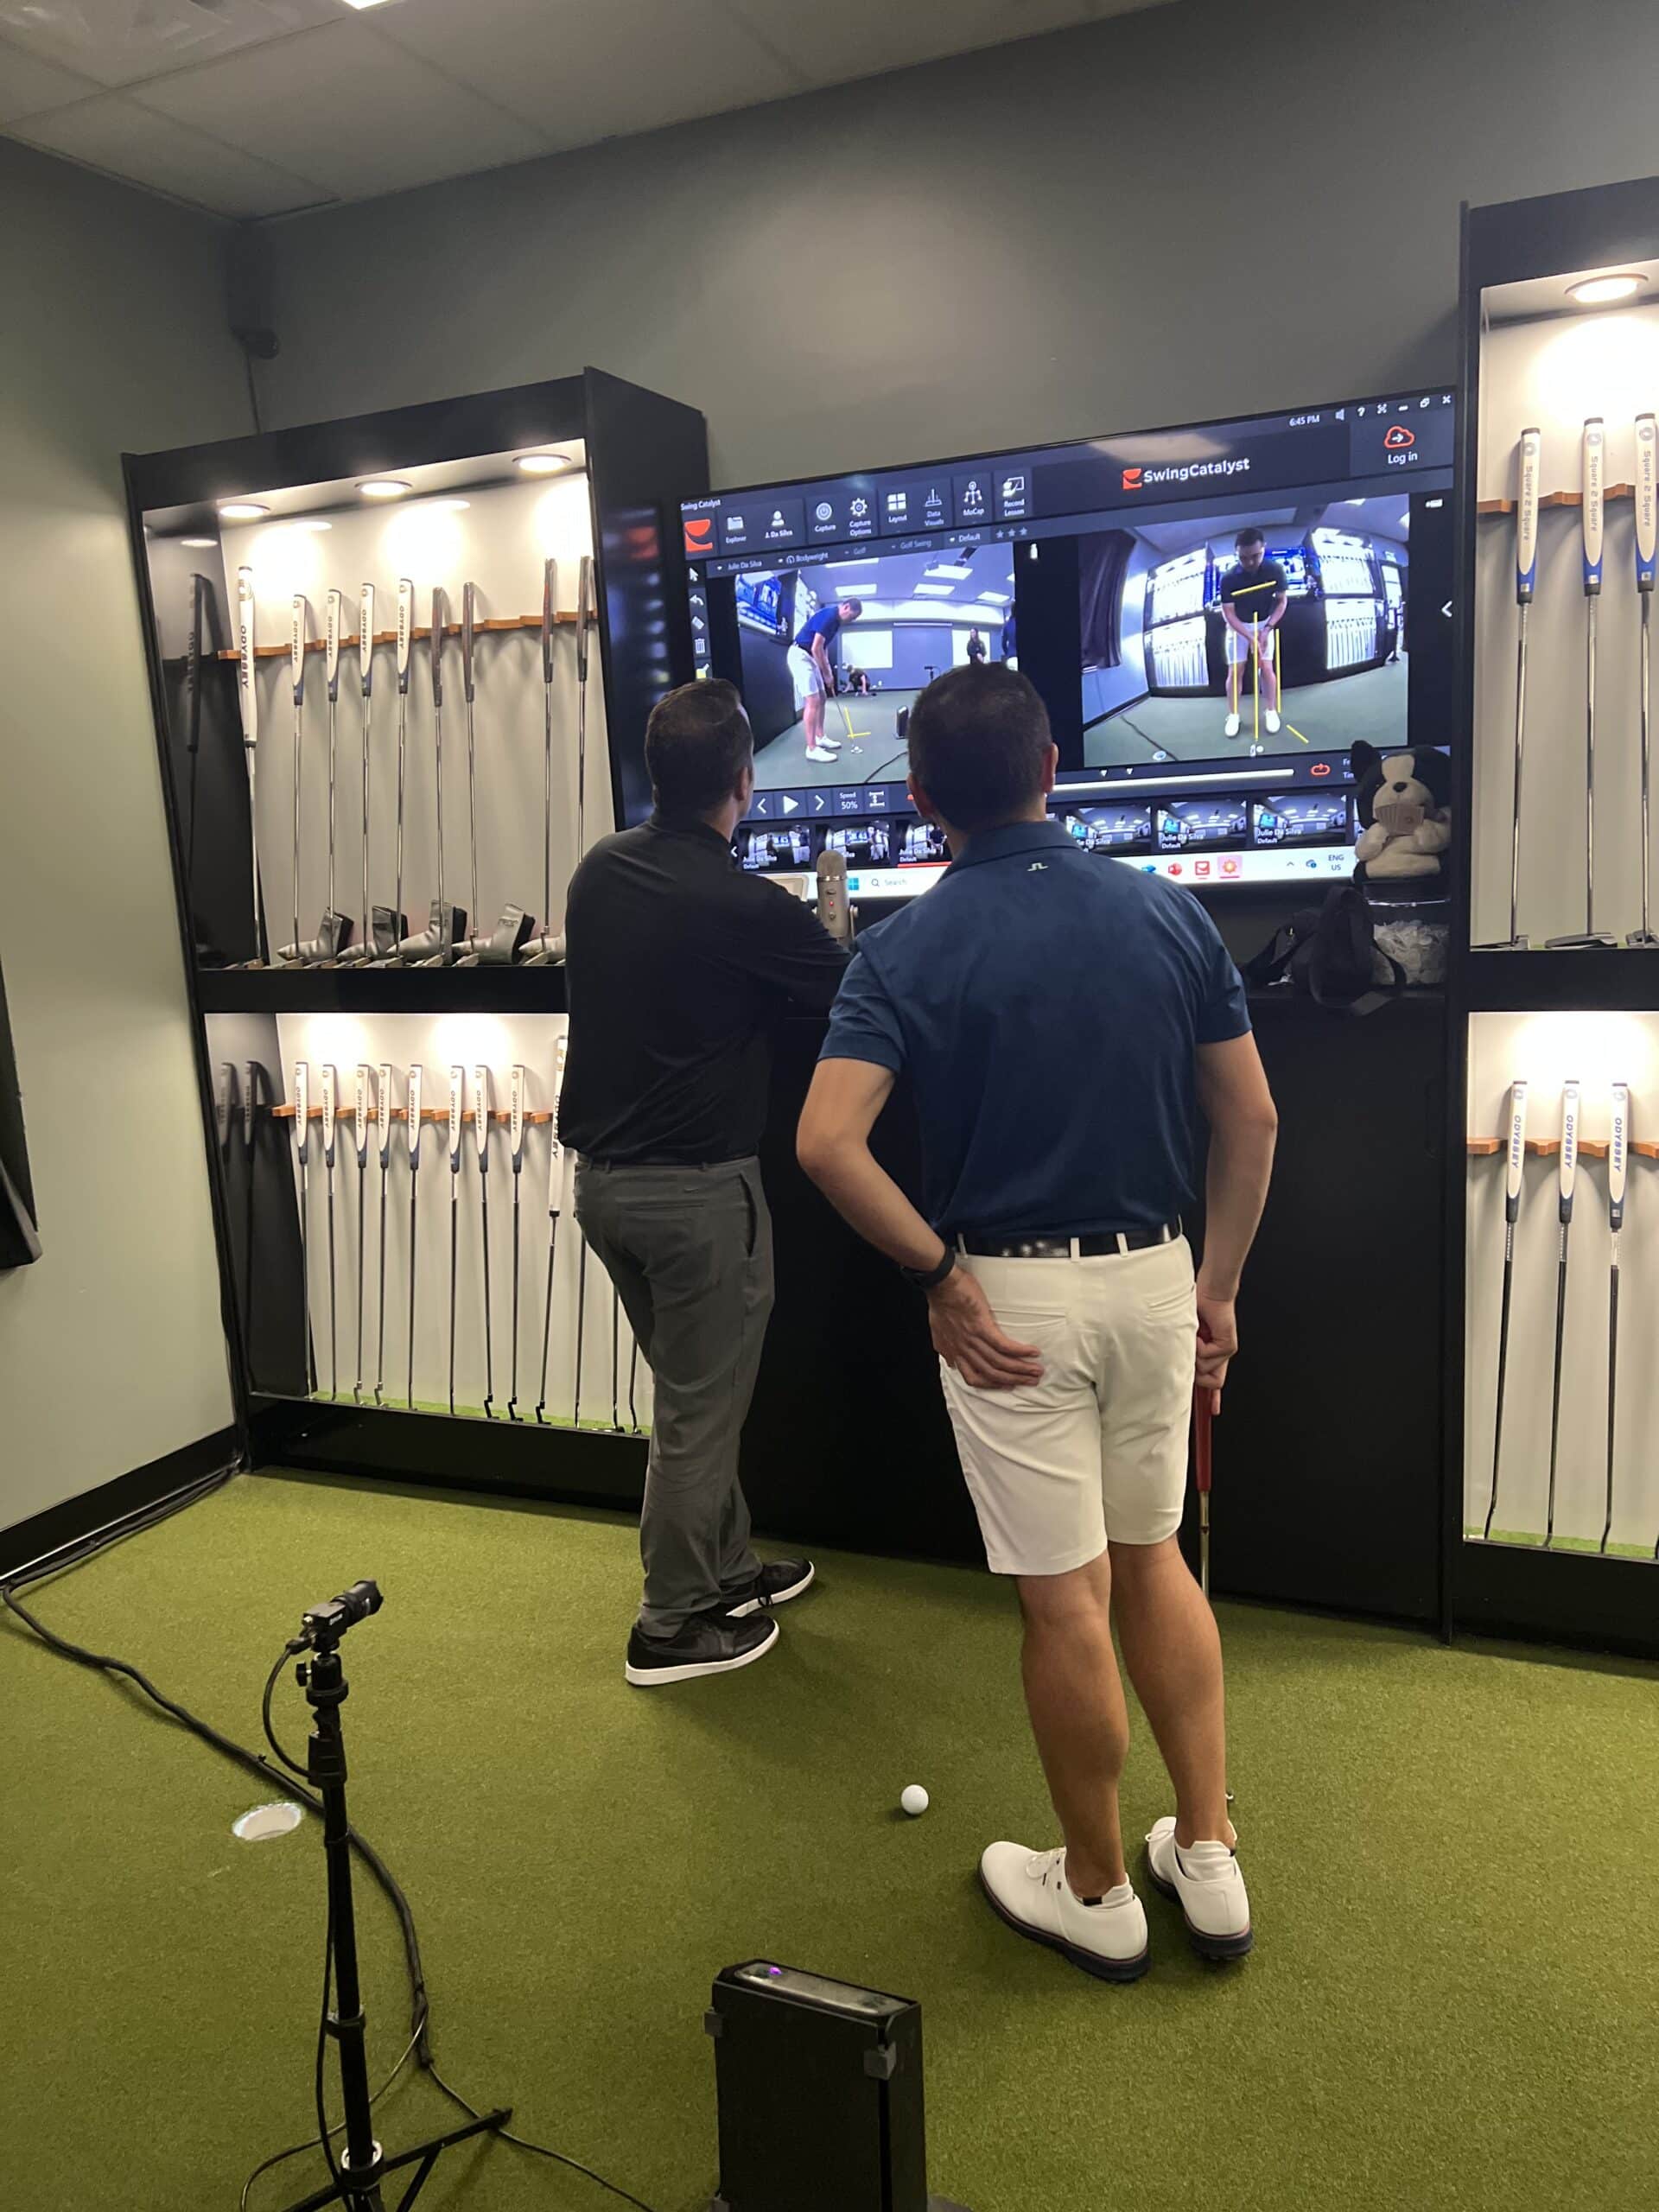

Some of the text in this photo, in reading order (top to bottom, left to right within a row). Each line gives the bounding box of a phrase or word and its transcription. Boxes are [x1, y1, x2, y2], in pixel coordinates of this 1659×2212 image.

[1289, 415, 1320, 427] 6:45 PM
[1143, 457, 1250, 484] SwingCatalyst
[1388, 451, 1418, 465] Log in
[1590, 455, 1599, 487] Square
[1642, 450, 1651, 481] Square
[1524, 466, 1533, 497] Square
[958, 533, 981, 543] Default
[240, 625, 249, 689] ODYSSEY
[841, 800, 858, 810] 50%
[884, 878, 907, 887] Search
[1512, 1115, 1522, 1168] ODYSSEY
[1564, 1115, 1573, 1168] ODYSSEY
[1613, 1117, 1623, 1173] ODYSSEY
